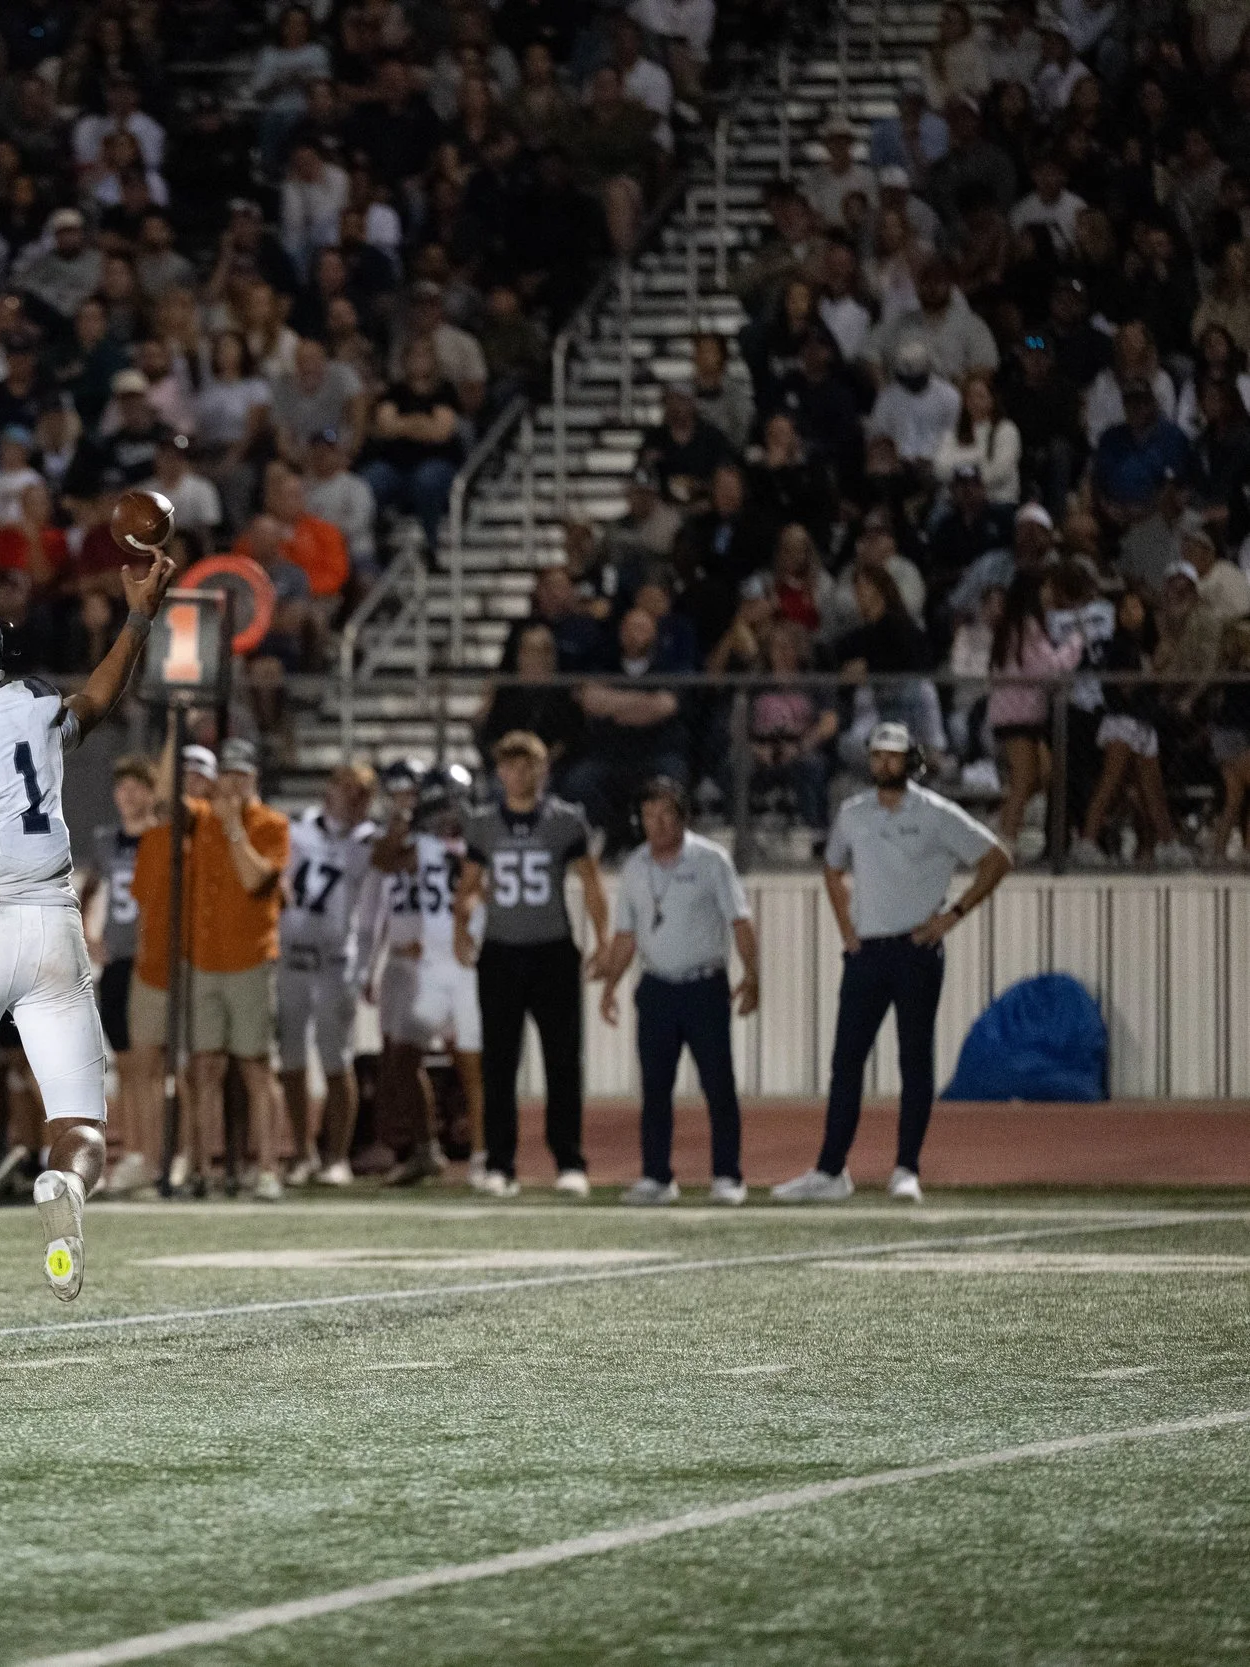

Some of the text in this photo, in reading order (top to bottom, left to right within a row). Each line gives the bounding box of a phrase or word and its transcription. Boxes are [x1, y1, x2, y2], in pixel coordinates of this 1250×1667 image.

[163, 604, 203, 682] 1
[14, 741, 51, 835] 1
[492, 850, 551, 908] 55
